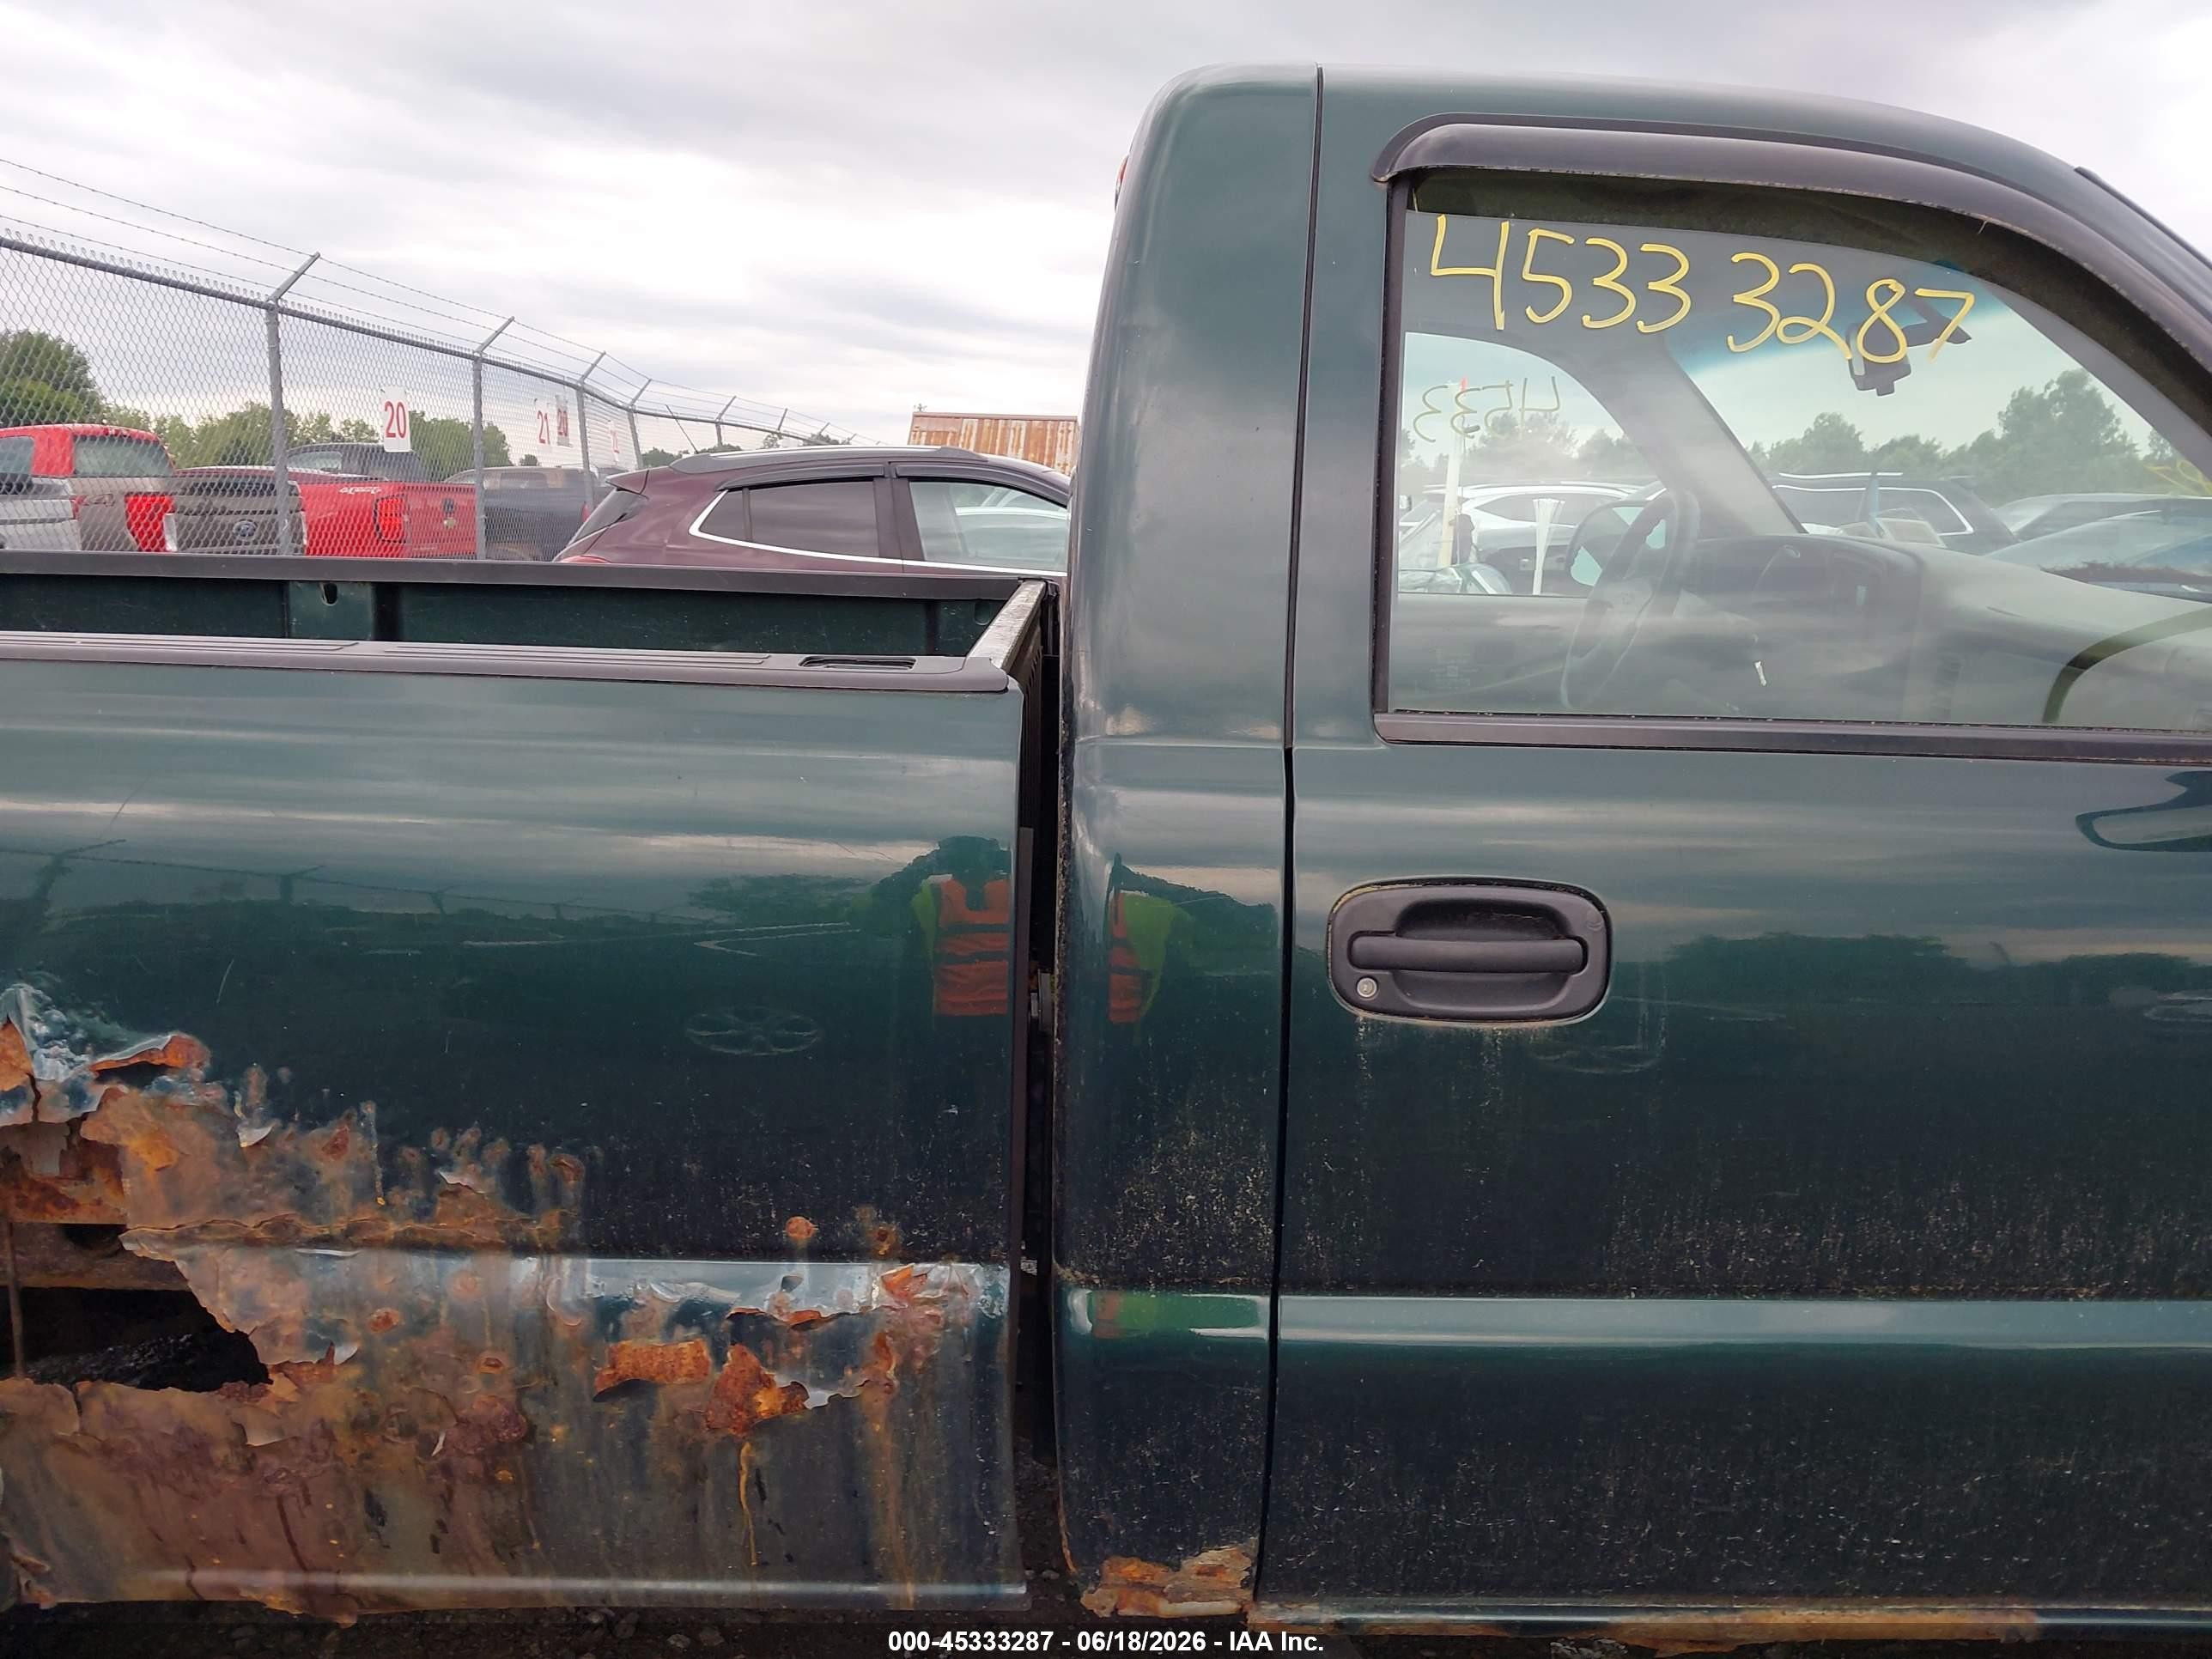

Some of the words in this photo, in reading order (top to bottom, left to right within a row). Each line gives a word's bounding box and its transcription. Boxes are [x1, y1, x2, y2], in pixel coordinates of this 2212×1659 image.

[1431, 214, 1692, 334] 4533
[1728, 252, 1975, 363] 3287
[384, 400, 407, 439] 20
[537, 410, 550, 445] 21
